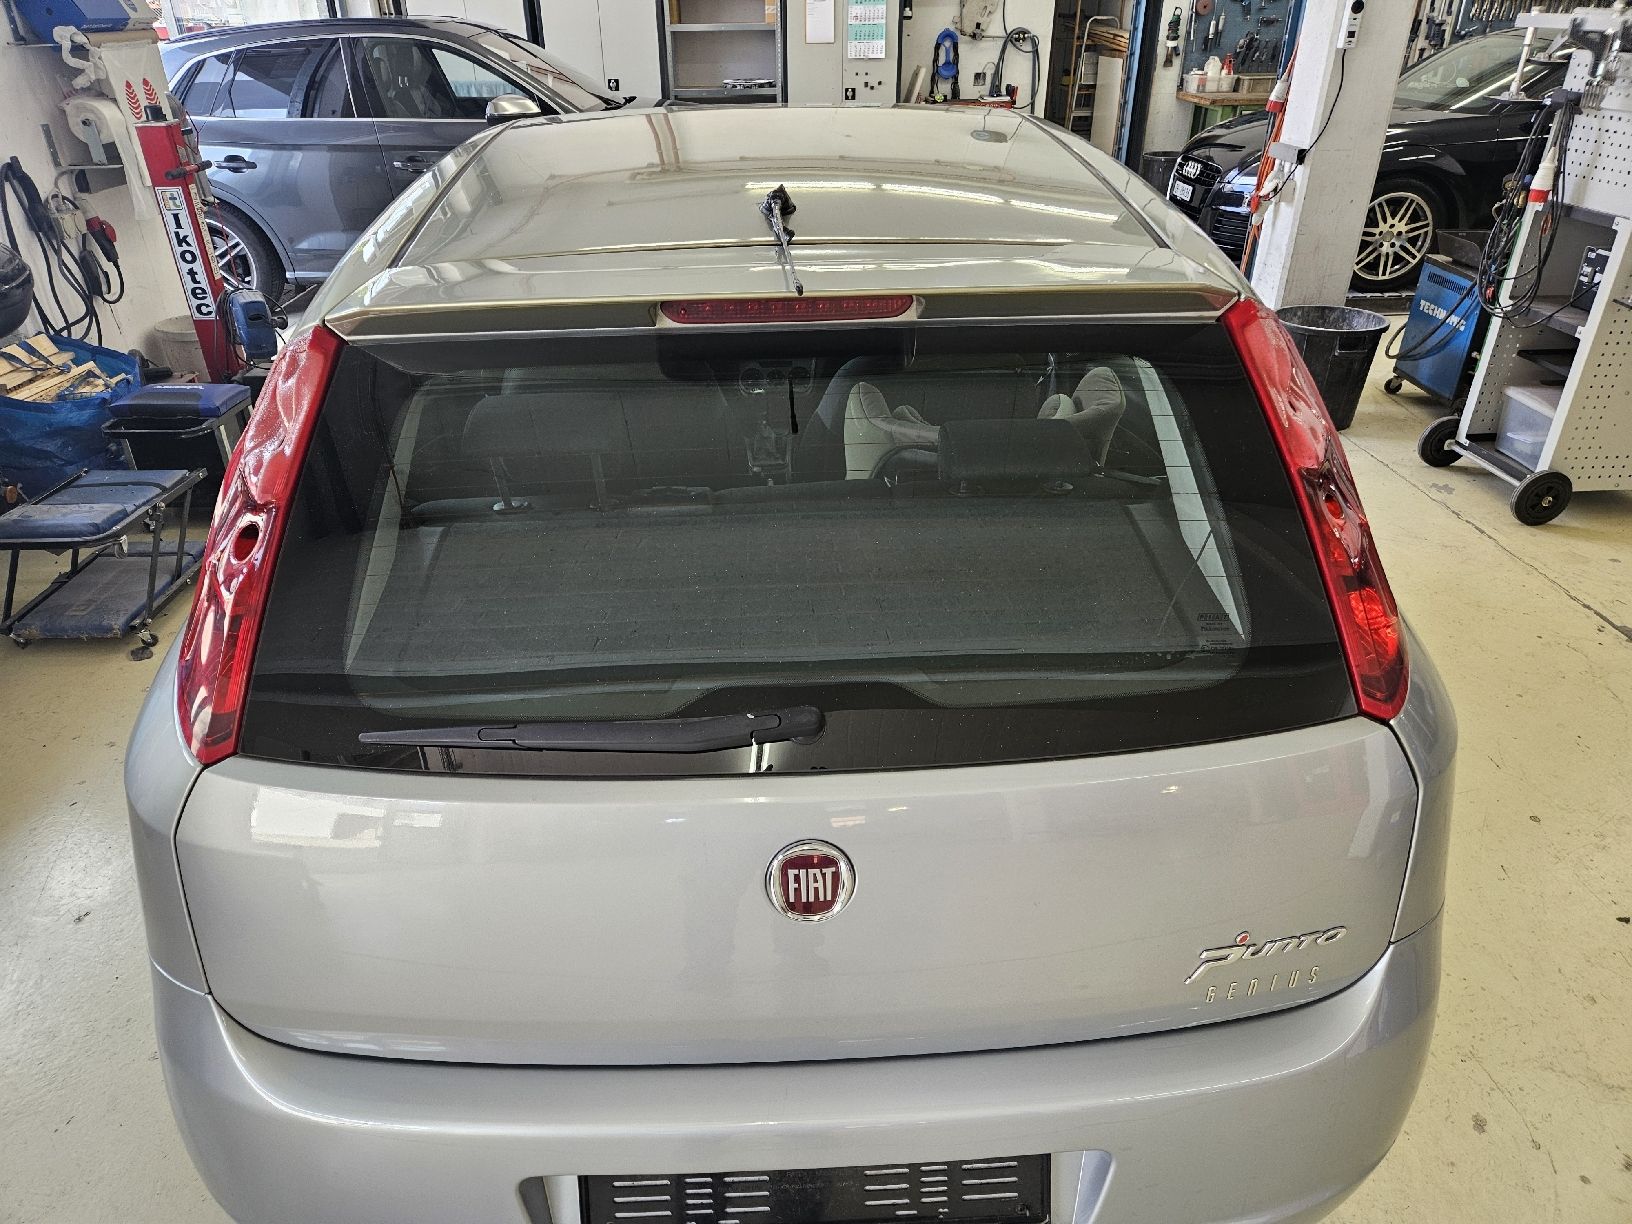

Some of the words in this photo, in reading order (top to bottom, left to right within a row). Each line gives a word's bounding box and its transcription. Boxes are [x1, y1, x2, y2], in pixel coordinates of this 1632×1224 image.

[170, 212, 214, 317] Ikotec
[1420, 299, 1467, 332] TECHNMC
[787, 867, 836, 903] FIAT
[1205, 965, 1320, 1003] GENIUS
